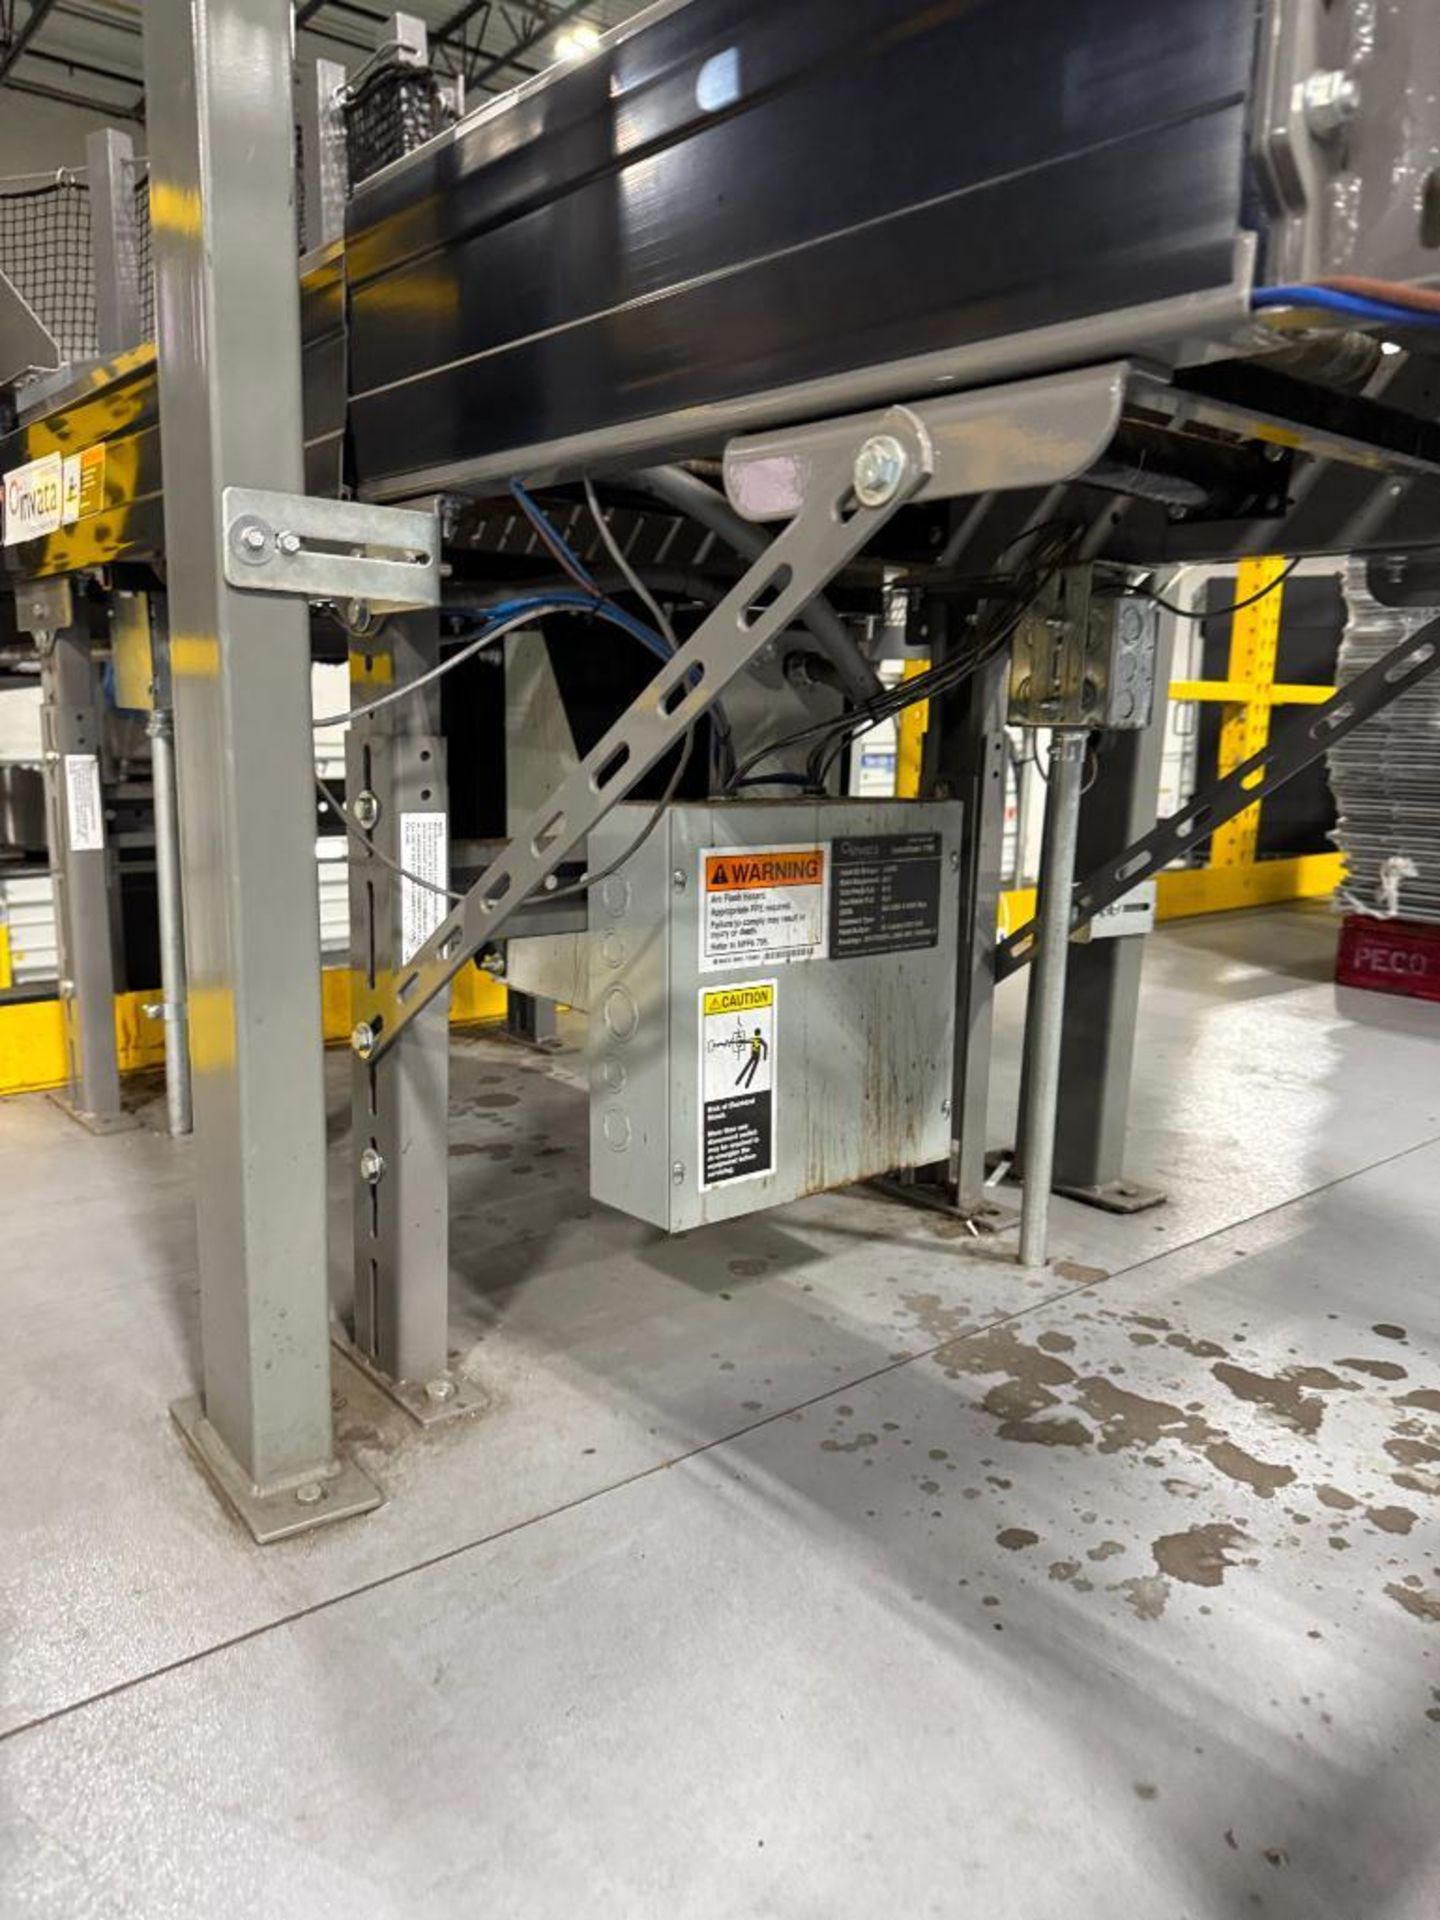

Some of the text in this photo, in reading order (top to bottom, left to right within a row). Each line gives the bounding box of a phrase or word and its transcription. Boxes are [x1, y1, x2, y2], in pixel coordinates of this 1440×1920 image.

[732, 860, 818, 883] WARNING
[724, 892, 741, 902] Flash
[711, 906, 749, 917] Appropriate
[711, 920, 733, 930] Failure
[743, 918, 764, 927] comply
[768, 917, 779, 925] may
[782, 914, 798, 922] result
[731, 930, 738, 938] or
[1354, 947, 1428, 976] PECO
[722, 990, 769, 1009] CAUTION
